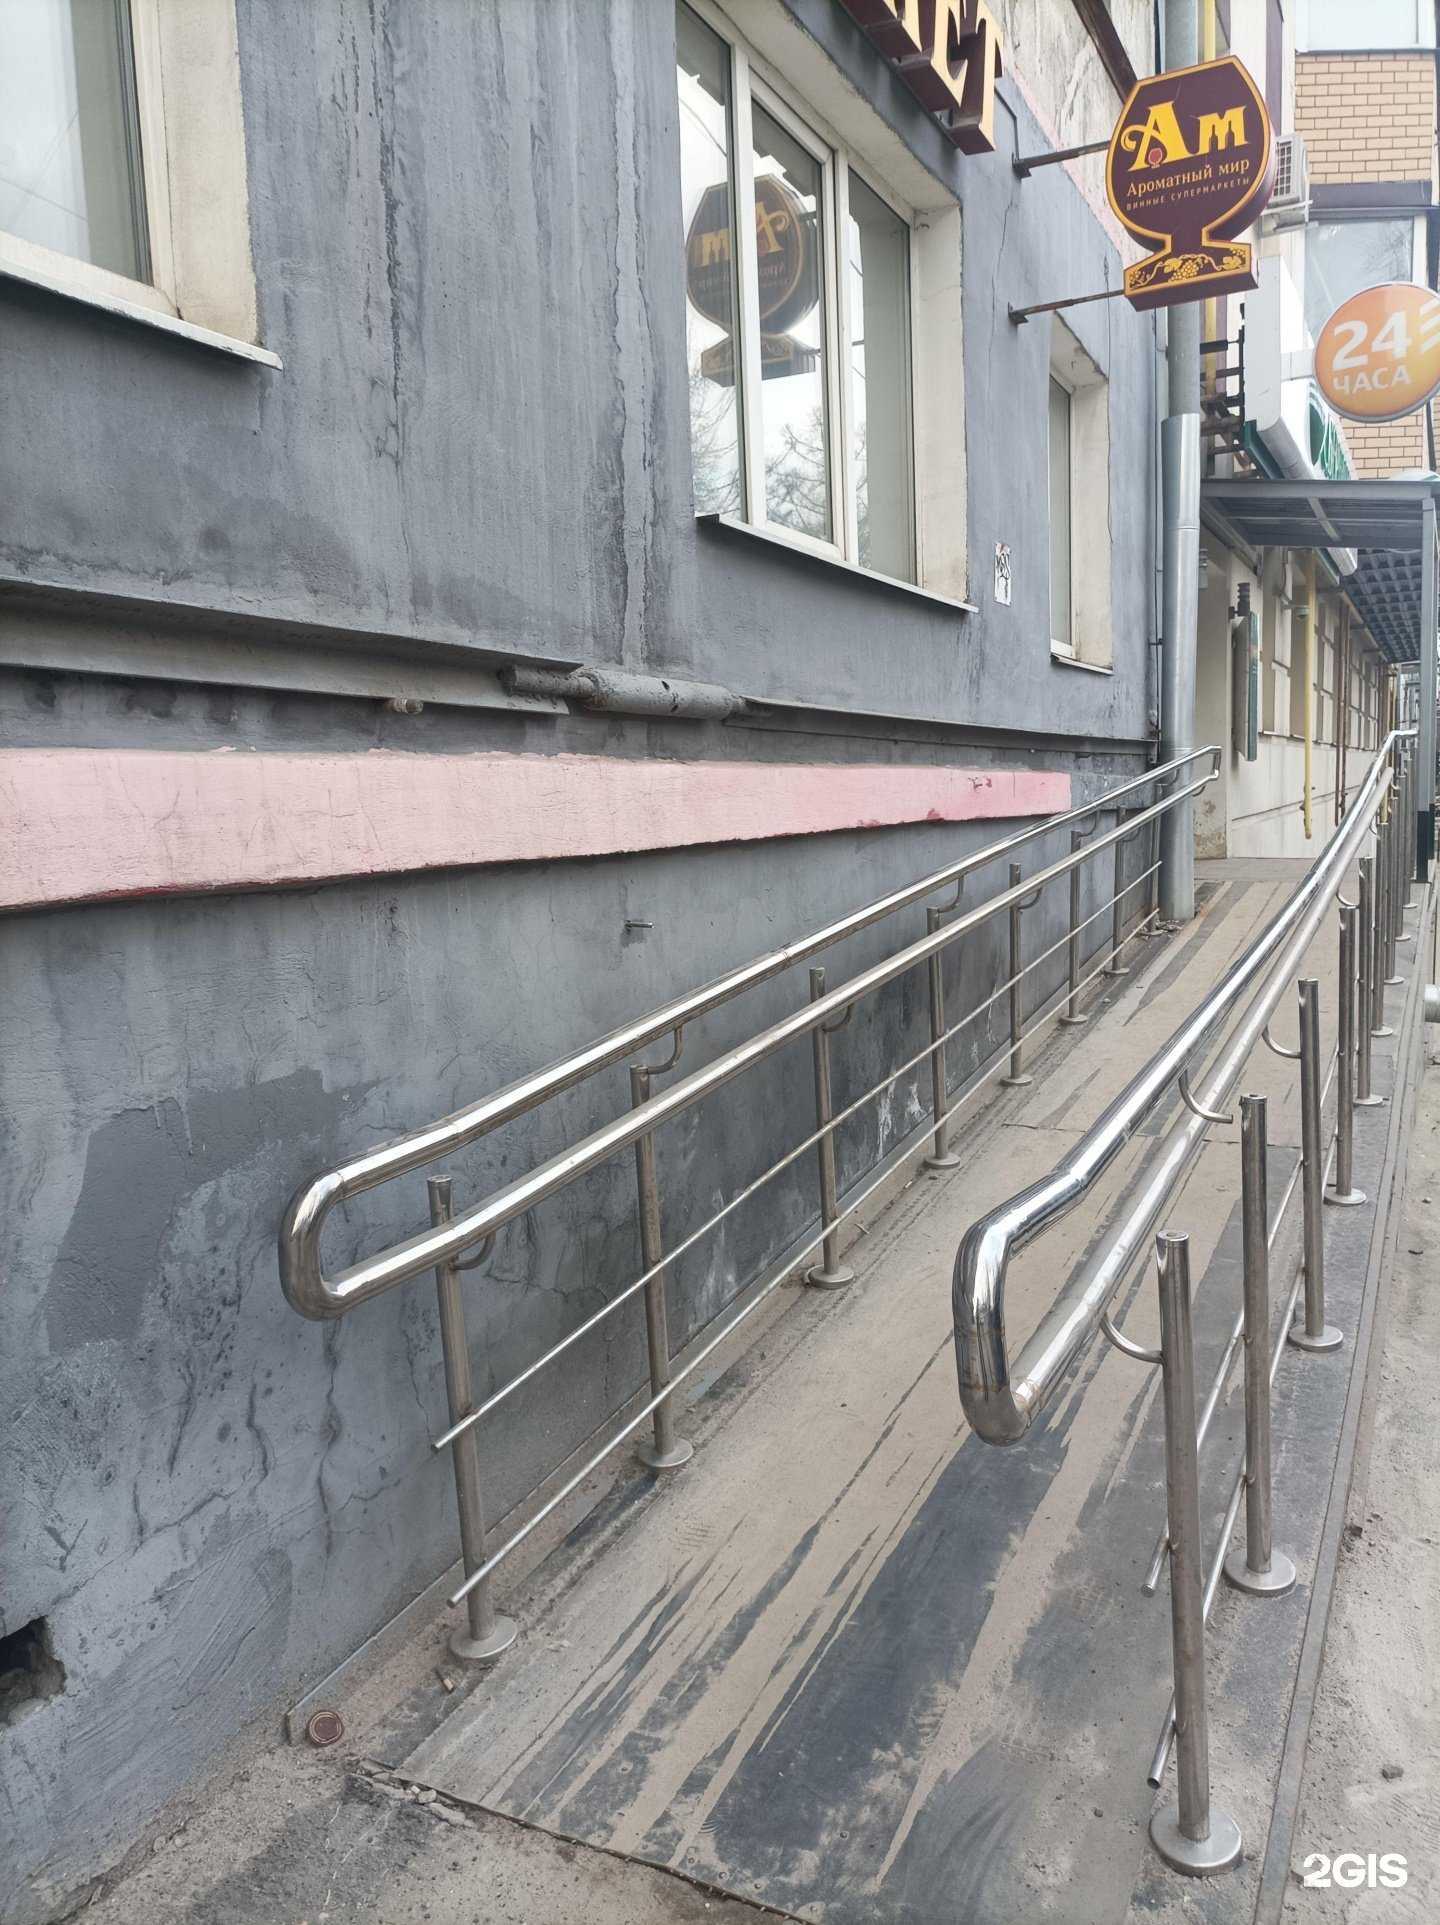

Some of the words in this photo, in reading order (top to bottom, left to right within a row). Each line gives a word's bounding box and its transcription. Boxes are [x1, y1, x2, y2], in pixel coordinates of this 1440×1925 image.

[1126, 195, 1165, 211] ВИННЫЕ
[1171, 178, 1249, 201] СУПЕРМАРКЕТЫ
[1127, 165, 1212, 197] Ароматный
[1219, 159, 1249, 174] мир
[1332, 311, 1413, 372] 24
[1333, 365, 1412, 395] ЧАСА
